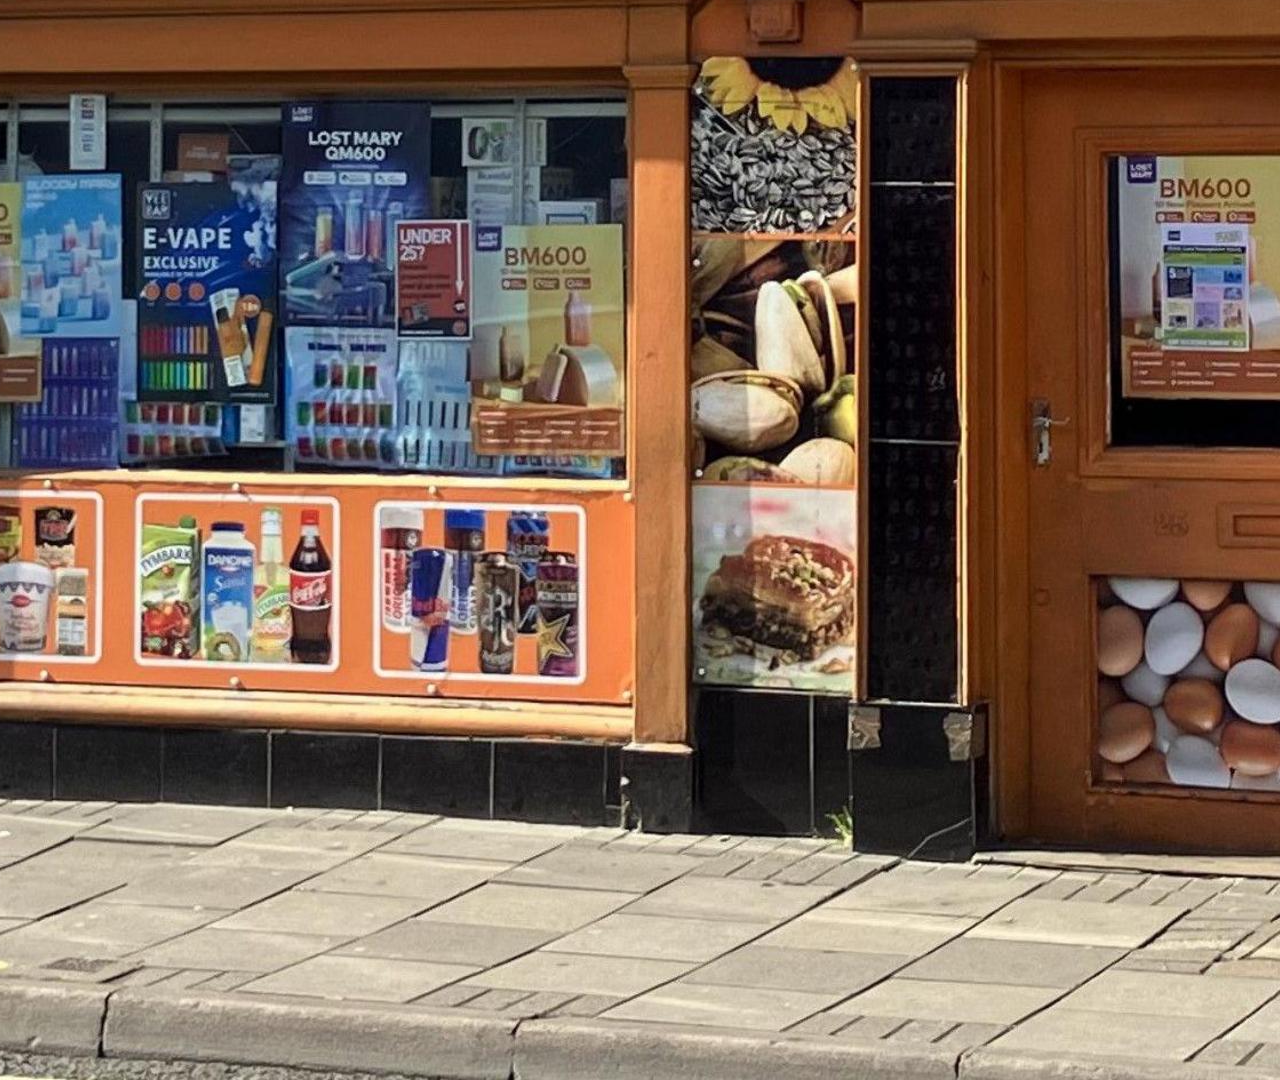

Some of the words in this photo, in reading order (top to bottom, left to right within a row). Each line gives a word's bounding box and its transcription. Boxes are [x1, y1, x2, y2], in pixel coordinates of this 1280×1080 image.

[308, 131, 351, 145] LOST
[354, 131, 403, 145] MARY
[325, 146, 386, 161] QM600
[1160, 178, 1251, 199] BM600
[143, 227, 232, 250] E-VAPE
[400, 228, 452, 244] UNDER
[143, 255, 220, 270] EXCLUSIVE
[504, 246, 587, 266] BM600
[207, 553, 253, 567] DANONE
